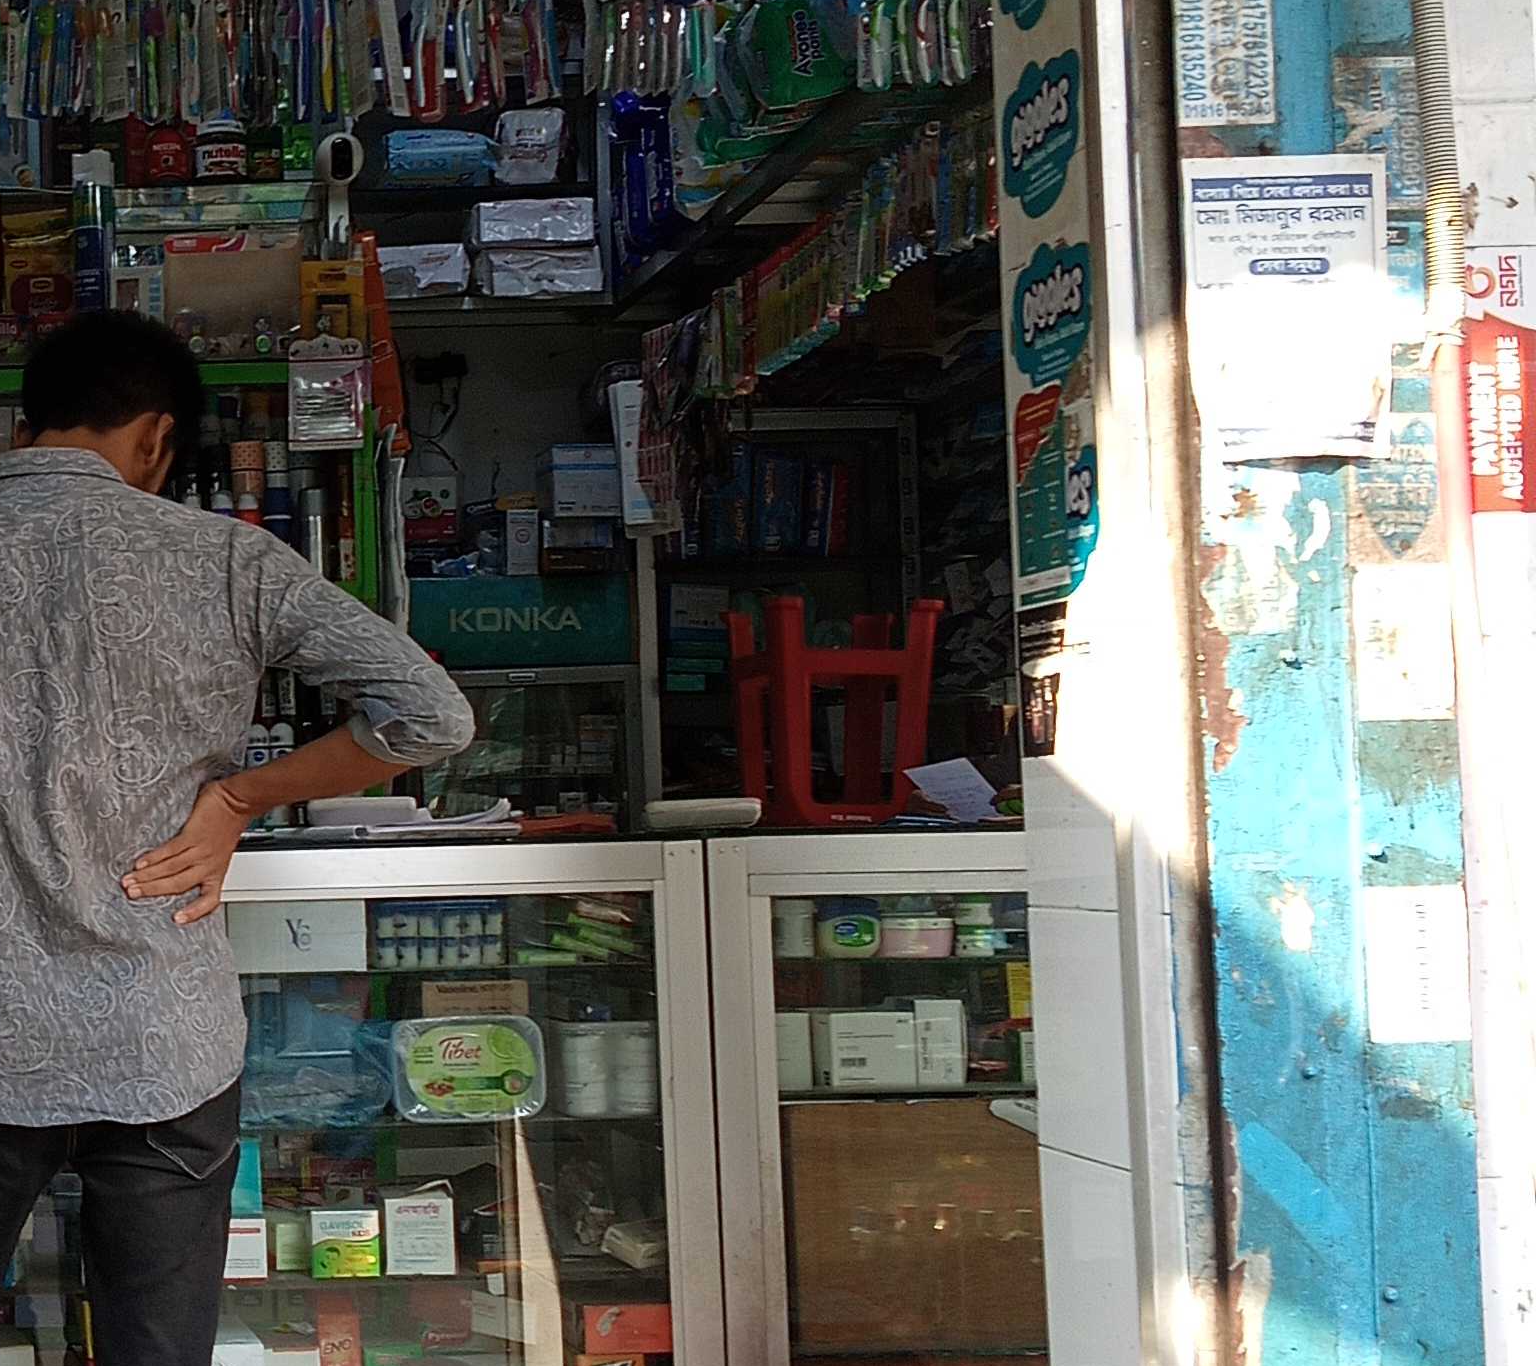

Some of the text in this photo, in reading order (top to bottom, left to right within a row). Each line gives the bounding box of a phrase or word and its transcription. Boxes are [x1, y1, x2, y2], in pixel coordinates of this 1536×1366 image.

[1011, 72, 1070, 169] giggles
[1308, 205, 1367, 224] রহমান
[1023, 262, 1083, 345] giggles
[1497, 254, 1522, 308] নগদ
[1468, 361, 1501, 477] PAYMENT
[1496, 334, 1525, 500] ACCEPTED HERE
[448, 603, 582, 633] KONKA
[438, 1035, 482, 1062] Tibet
[322, 1337, 352, 1354] ENO
